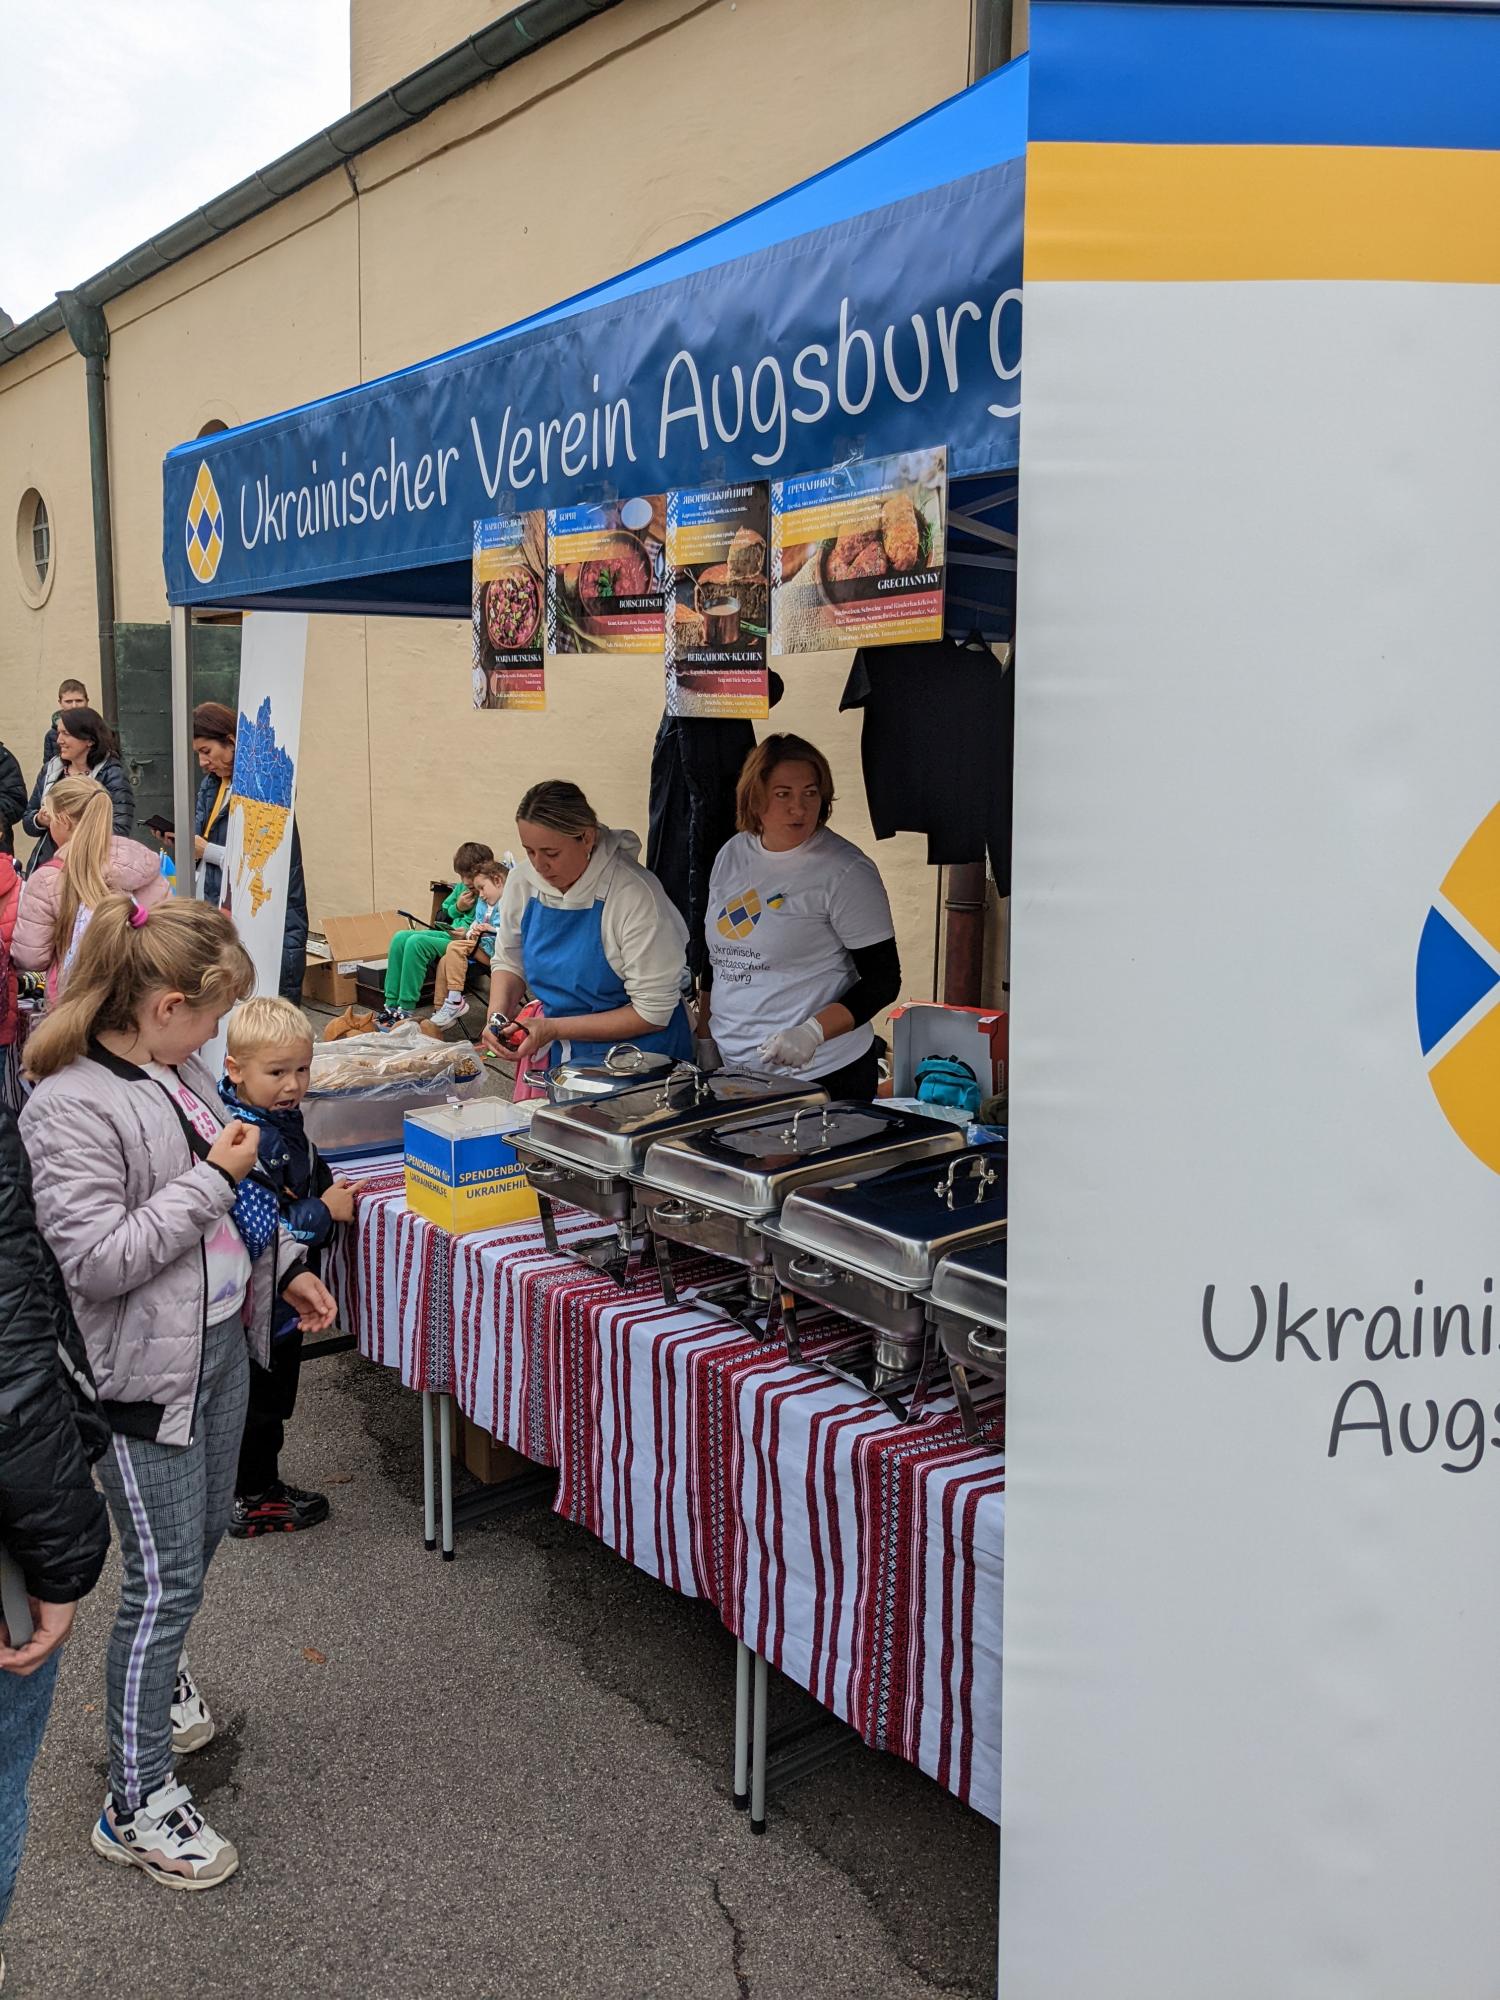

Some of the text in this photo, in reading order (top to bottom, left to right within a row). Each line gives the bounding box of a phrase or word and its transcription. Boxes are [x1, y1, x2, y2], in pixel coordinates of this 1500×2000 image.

[240, 437, 460, 550] Ukrainischer
[470, 374, 637, 500] Verein
[877, 572, 940, 590] GRECHANYKY
[406, 1153, 442, 1178] SPENDENBOX
[466, 1178, 528, 1199] UKRAINEHIL
[1202, 1277, 1500, 1362] Ukraini
